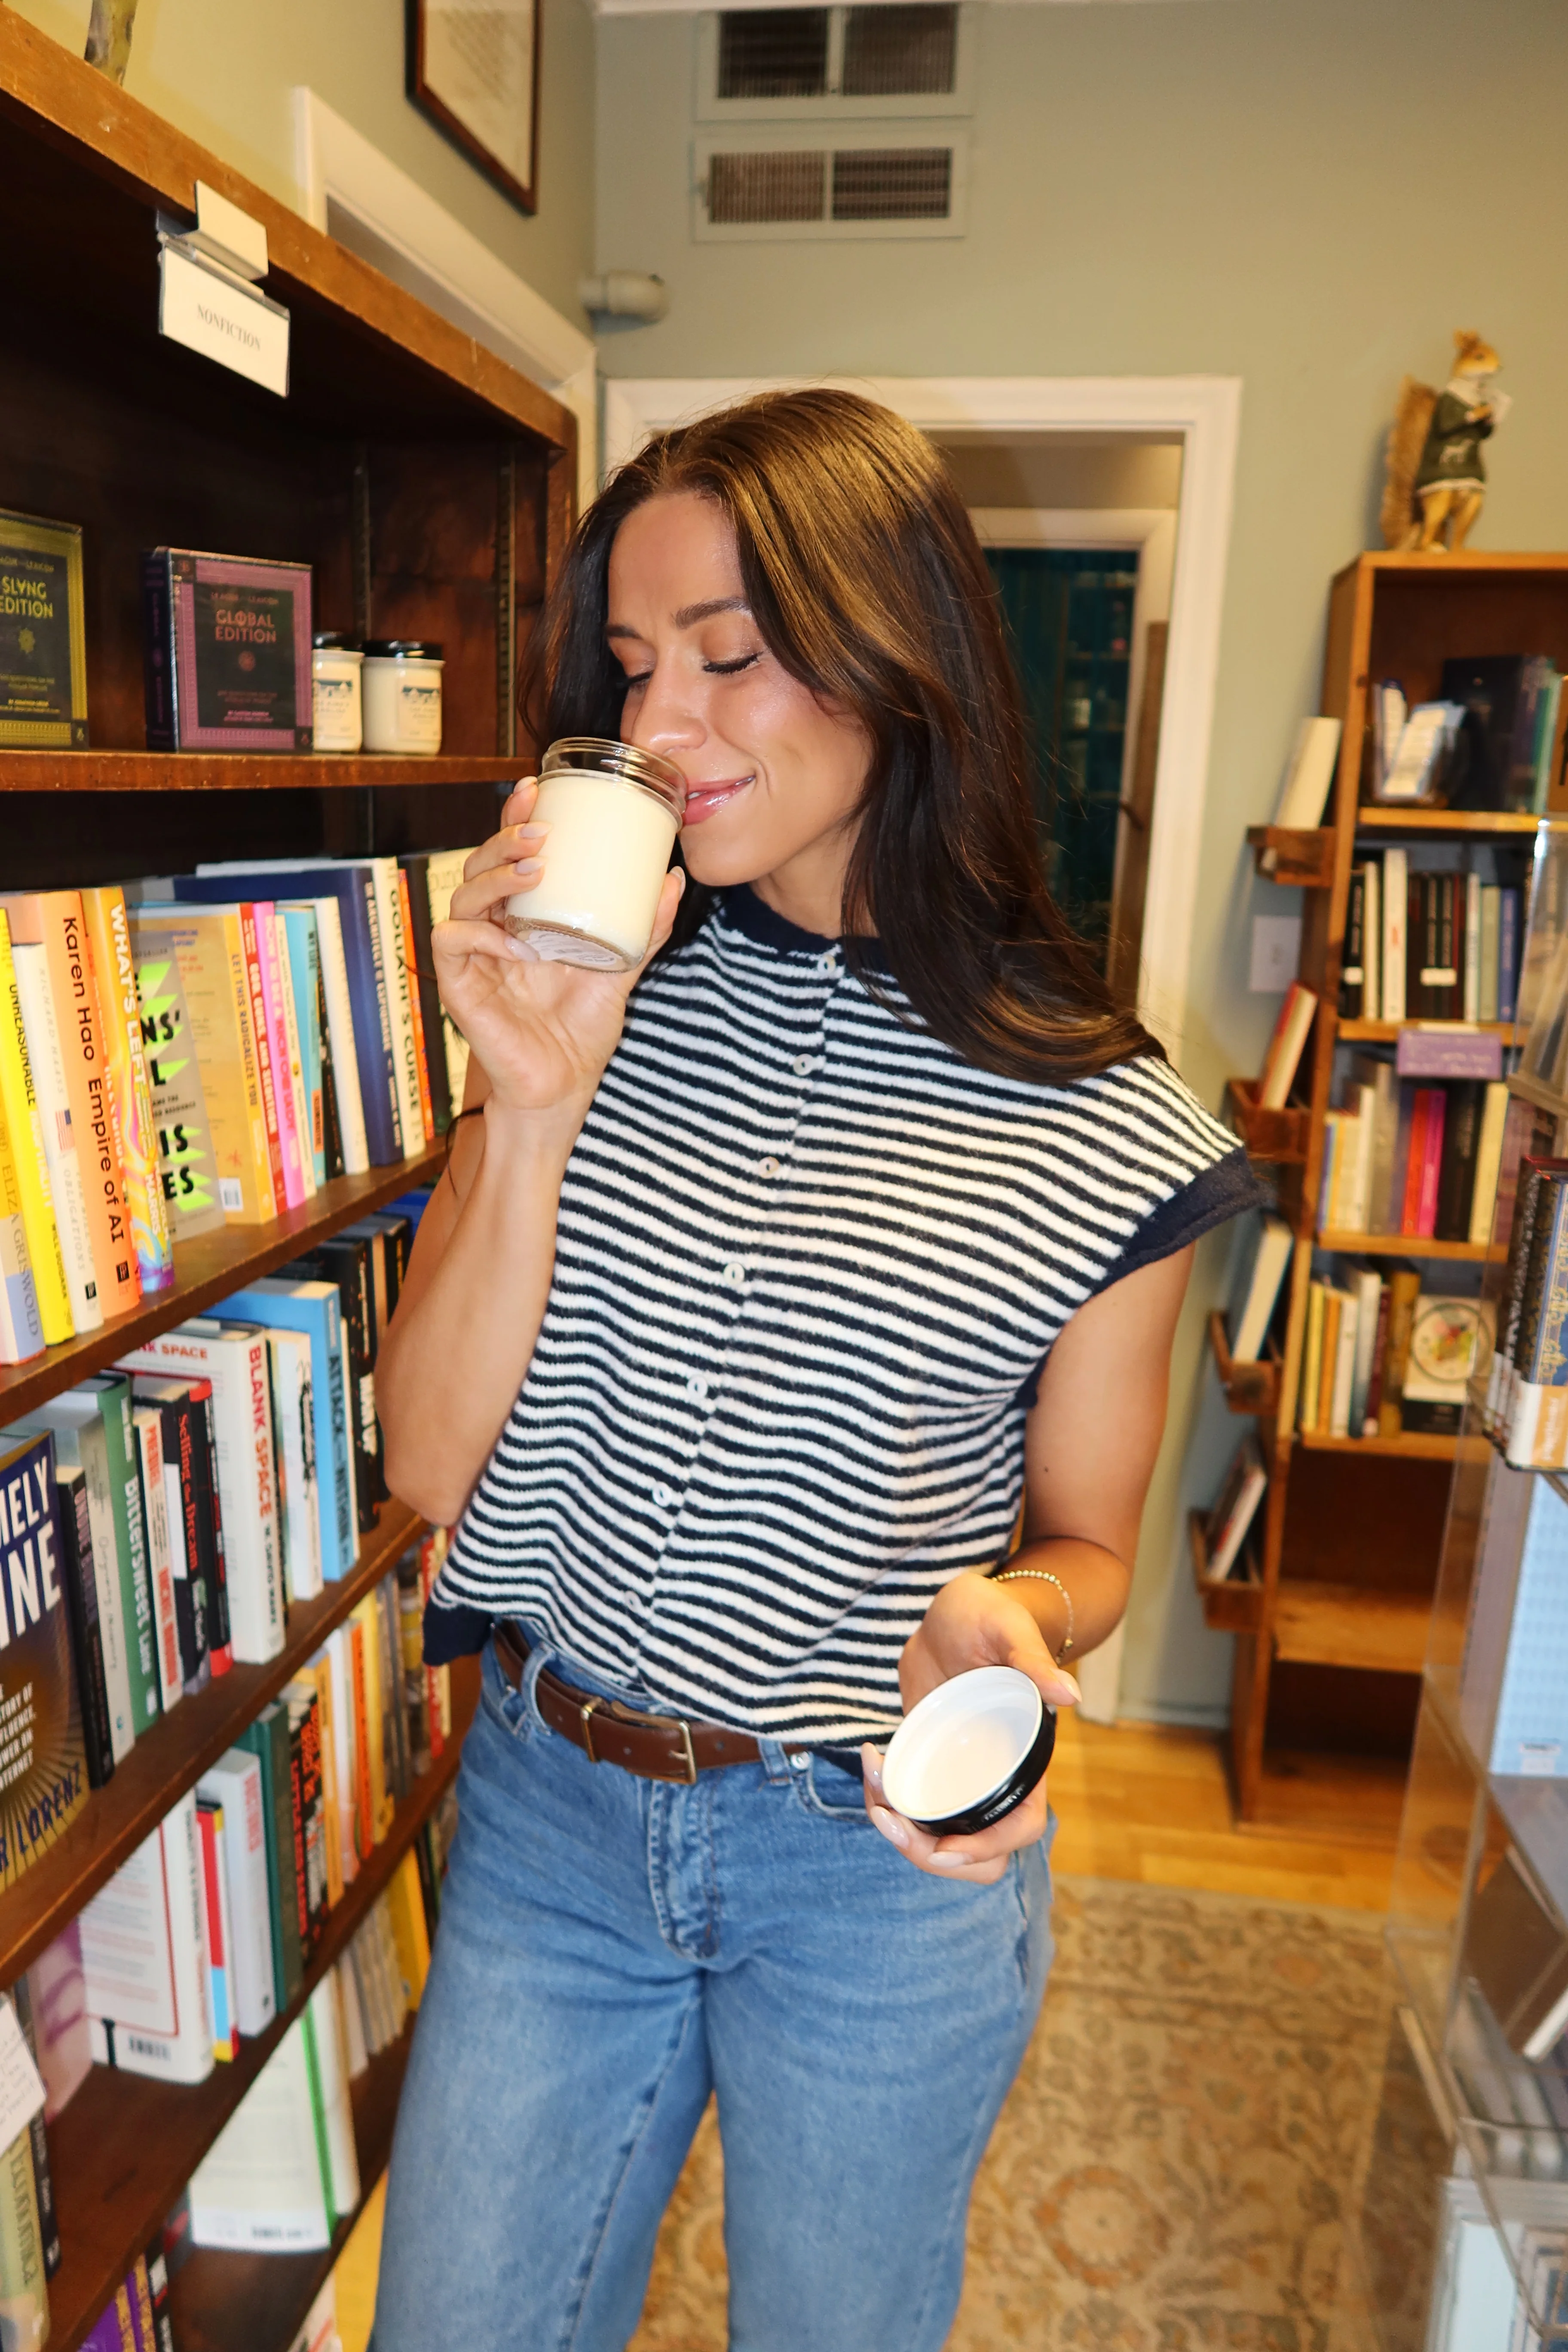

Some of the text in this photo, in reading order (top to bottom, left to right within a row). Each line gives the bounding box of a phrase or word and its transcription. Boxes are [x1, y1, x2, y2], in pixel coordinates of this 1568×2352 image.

[197, 303, 261, 351] NONFICTION
[215, 627, 277, 643] EDITION
[216, 609, 275, 629] GLOBAL
[63, 917, 94, 1061] Karen Hao
[111, 903, 136, 1014] WHAT'S
[126, 1019, 146, 1084] LEFT
[232, 954, 241, 974] LET
[235, 980, 245, 1007] THIS
[390, 888, 419, 1111] GOLIATH'S CURSE
[9, 983, 36, 1106] UNREASONABLE
[88, 1078, 111, 1172] Empire
[248, 1084, 257, 1106] YOU
[104, 1180, 119, 1204] of
[108, 1214, 124, 1243] AI
[3, 1164, 39, 1336] ELIZA GRISWOLD
[160, 1343, 208, 1360] SPACE
[249, 1344, 271, 1518] BLANK SPACE
[0, 1456, 49, 1547] ELY
[179, 1413, 192, 1483] Selling
[186, 1502, 199, 1571] Dream
[125, 1474, 151, 1629] Bittersweet
[16, 1761, 82, 1856] LORENZ
